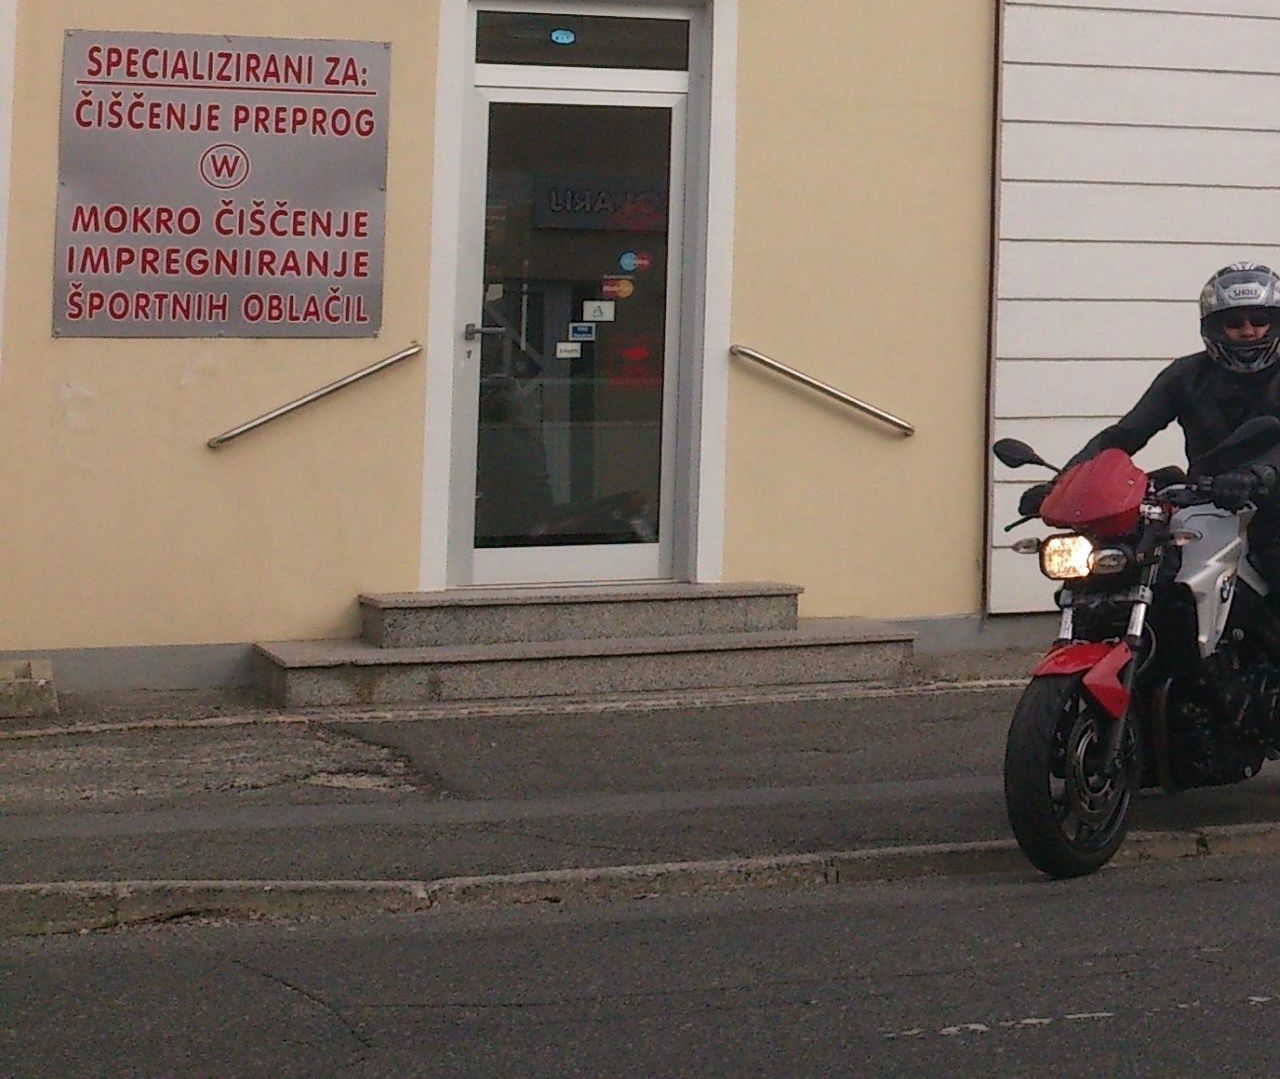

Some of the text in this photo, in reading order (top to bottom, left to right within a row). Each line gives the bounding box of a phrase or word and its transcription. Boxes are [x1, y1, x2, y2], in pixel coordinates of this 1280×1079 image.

[86, 46, 368, 87] SPECIALIZIRANI ZA:
[75, 89, 375, 137] ČIŠČENJE PREPROG
[71, 199, 369, 238] MOKRO ČIŠČENJE
[66, 246, 370, 278] IMPREGNIRANJE
[66, 282, 369, 323] ŠPORTNIH OBLAČIL
